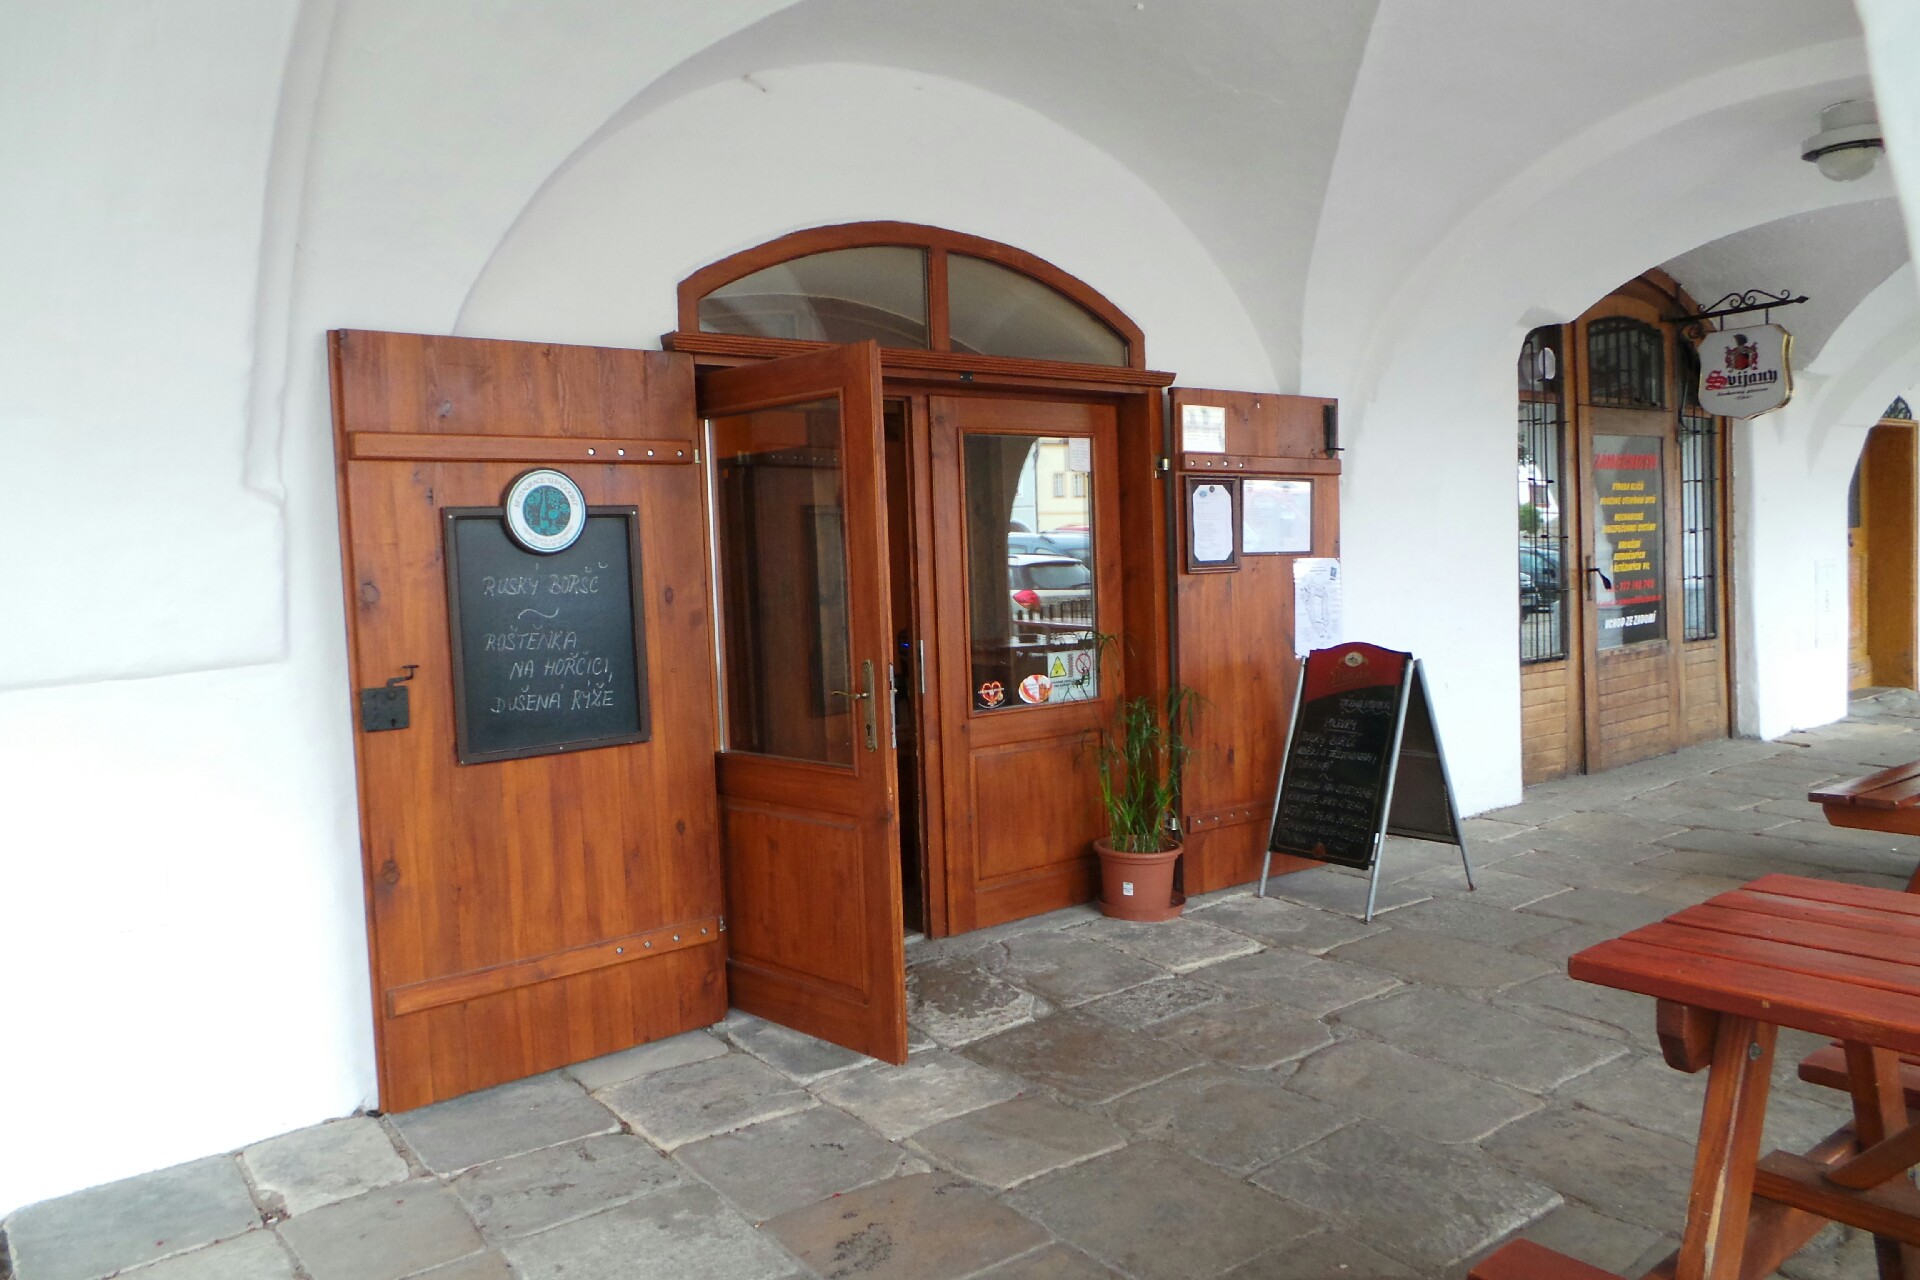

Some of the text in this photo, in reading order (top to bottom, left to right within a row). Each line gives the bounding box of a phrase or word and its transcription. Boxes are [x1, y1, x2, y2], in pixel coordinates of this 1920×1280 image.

[1705, 369, 1777, 390] Svijany
[483, 562, 608, 596] RUSKÝ BORŠČ
[485, 624, 577, 650] ROŠTĚNKA
[509, 659, 534, 680] NA
[490, 680, 614, 713] DUŠENÁ RÝŽE
